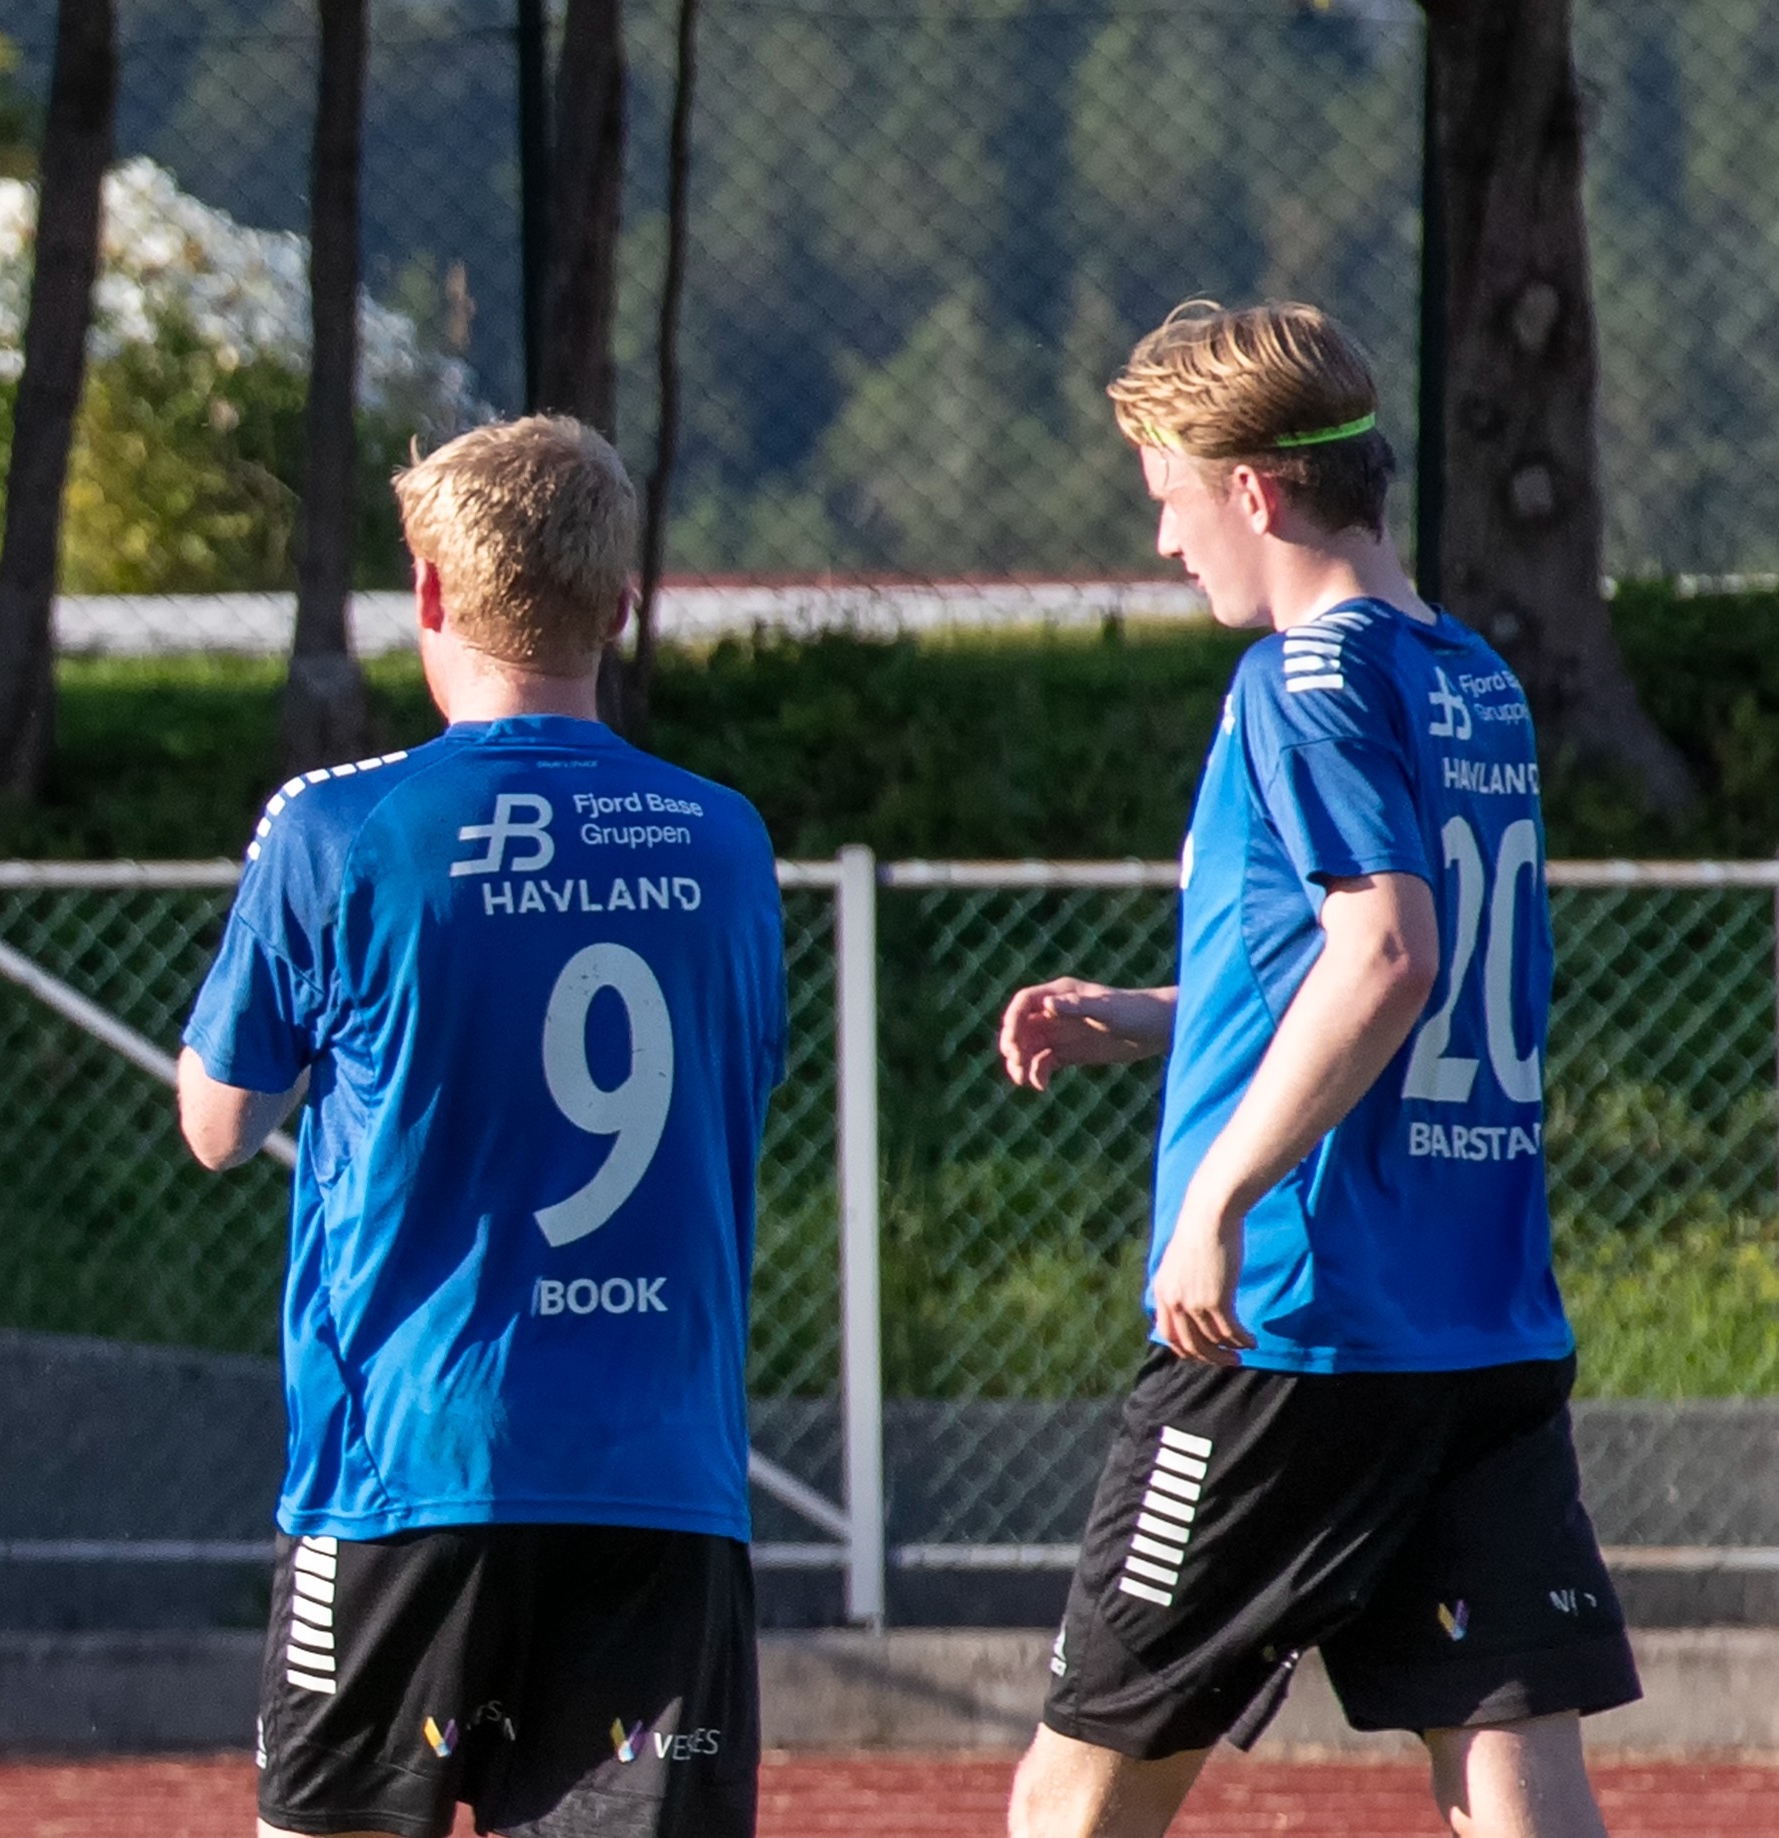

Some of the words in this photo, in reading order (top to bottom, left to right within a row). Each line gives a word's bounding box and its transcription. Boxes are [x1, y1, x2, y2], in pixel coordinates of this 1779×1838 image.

[572, 793, 643, 818] Fjord
[644, 793, 704, 817] Base
[581, 823, 692, 849] Gruppen
[482, 875, 702, 916] HAVLAND
[1400, 815, 1542, 1103] 20
[533, 942, 674, 1247] 9
